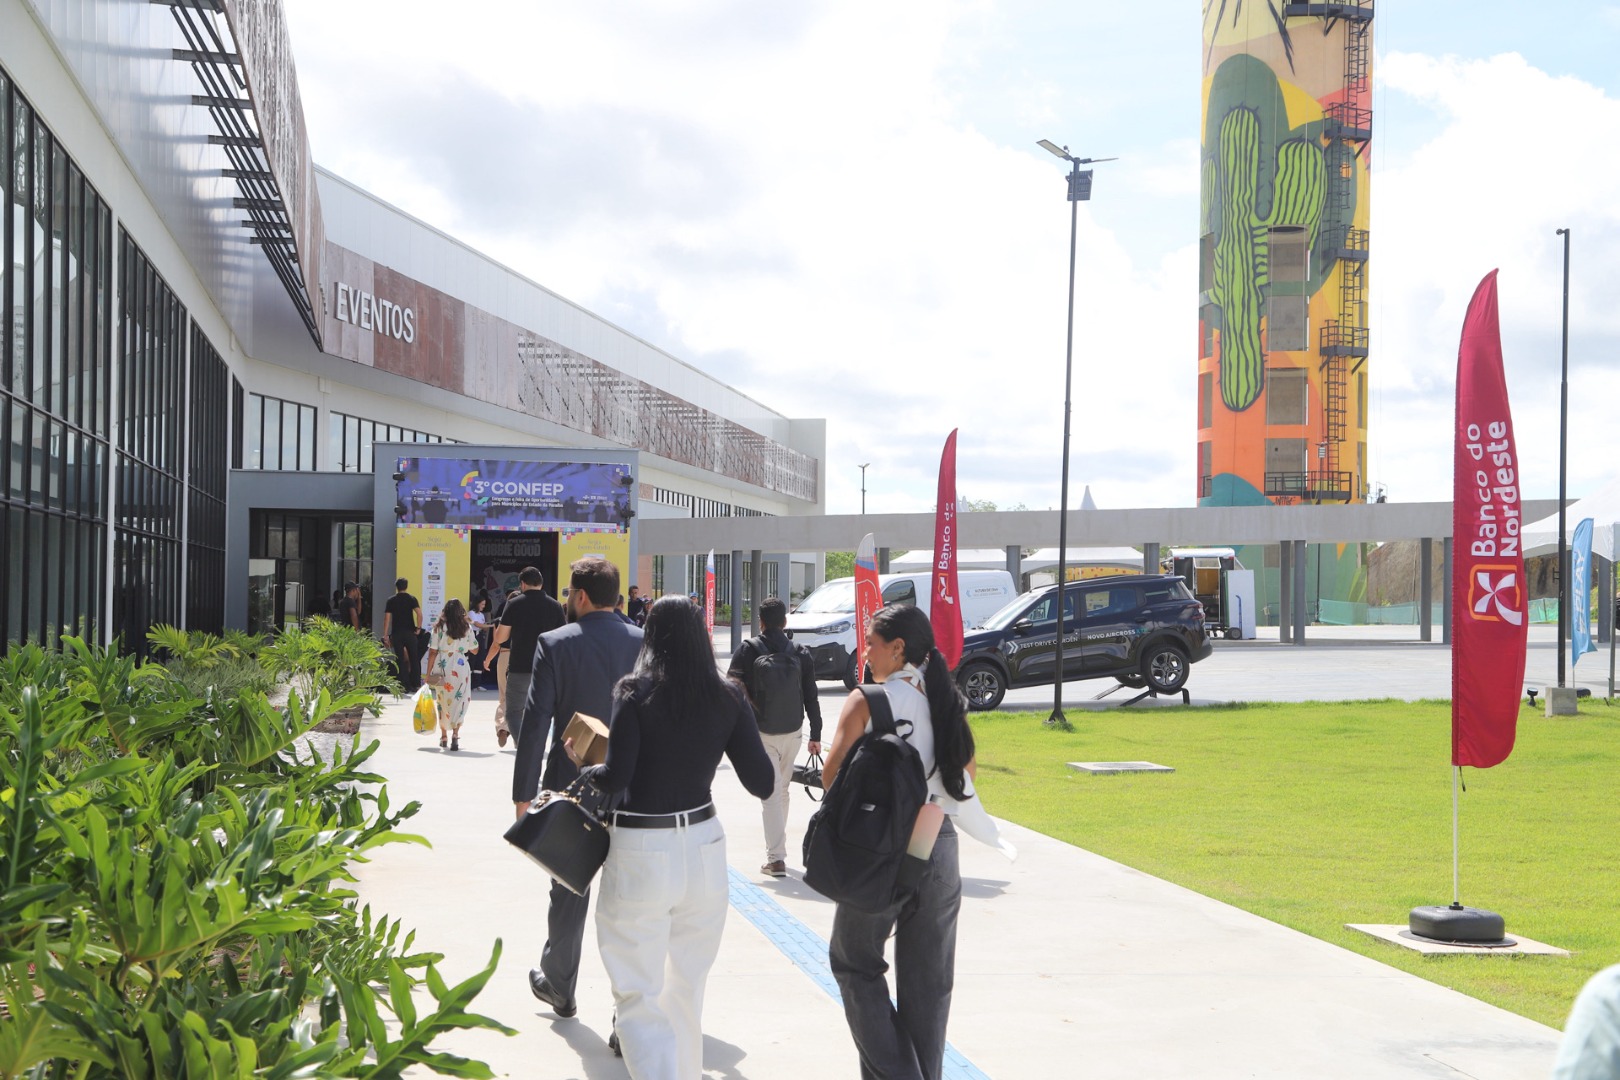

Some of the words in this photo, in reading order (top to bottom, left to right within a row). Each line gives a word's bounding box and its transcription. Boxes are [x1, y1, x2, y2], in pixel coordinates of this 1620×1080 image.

[335, 282, 414, 343] EVENTOS
[1466, 423, 1484, 461] do
[491, 481, 564, 496] CONFEP
[1487, 421, 1519, 557] Nordeste
[1471, 470, 1498, 557] Banco
[477, 543, 513, 556] BOBBIE
[938, 525, 951, 570] Banco
[1051, 636, 1079, 646] CROËN
[1087, 633, 1105, 641] NOVO
[1105, 629, 1136, 638] AIRCROSS
